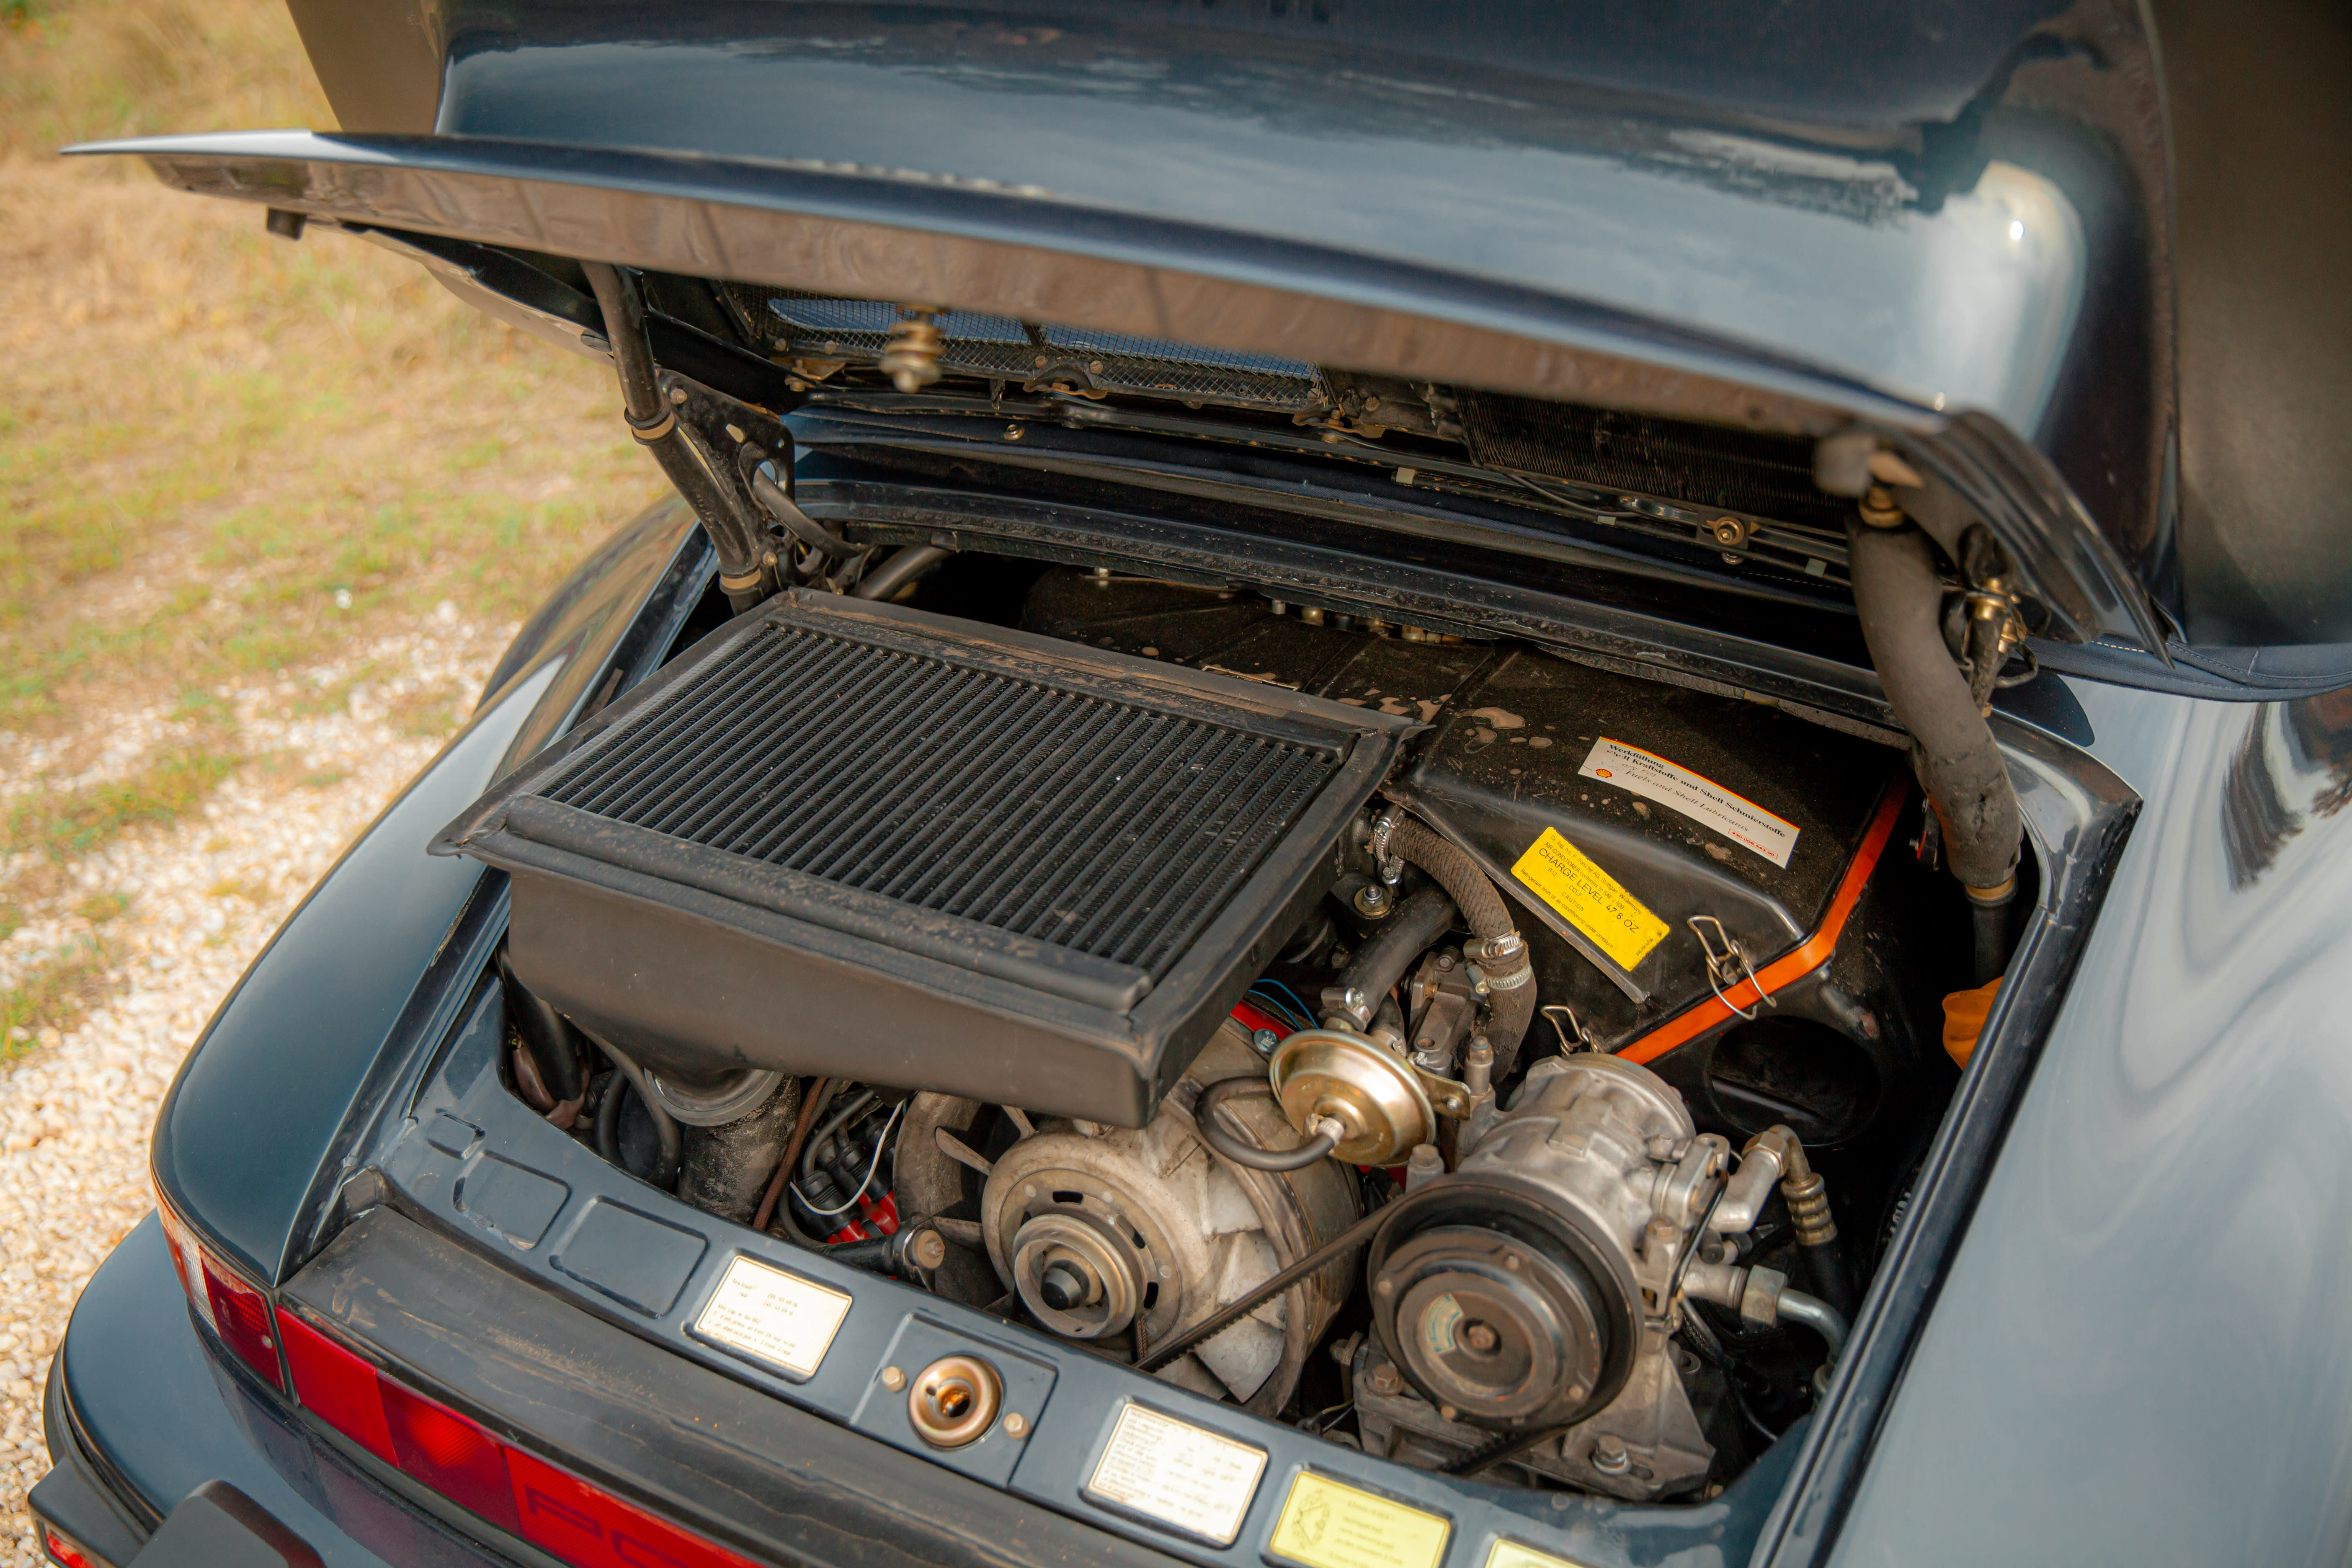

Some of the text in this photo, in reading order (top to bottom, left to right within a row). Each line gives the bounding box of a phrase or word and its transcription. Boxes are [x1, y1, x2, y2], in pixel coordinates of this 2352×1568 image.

[1610, 745, 1664, 769] Werkfüllung
[1625, 770, 1749, 831] Fuels and Shell Lubricants
[1632, 758, 1678, 781] Kraftstoffe
[1681, 780, 1698, 790] und
[1700, 789, 1723, 804] Shell
[1725, 802, 1785, 838] Schmierstoffe
[1540, 848, 1577, 881] CHARGE
[1577, 879, 1602, 904] LEVEL
[1624, 919, 1639, 933] OZ
[1545, 842, 1580, 872] AIR-CONDITIONER
[1580, 872, 1598, 888] conforms
[1577, 858, 1593, 872] Porsche
[1601, 878, 1618, 893] Stuttgart
[1620, 893, 1641, 914] W-Germany
[1521, 869, 1542, 887] Refrigerant
[1542, 886, 1551, 895] lines
[1556, 899, 1585, 923] air-conditioning
[1585, 923, 1596, 933] under
[1596, 933, 1613, 948] pressure
[1562, 892, 1584, 911] CAUTION
